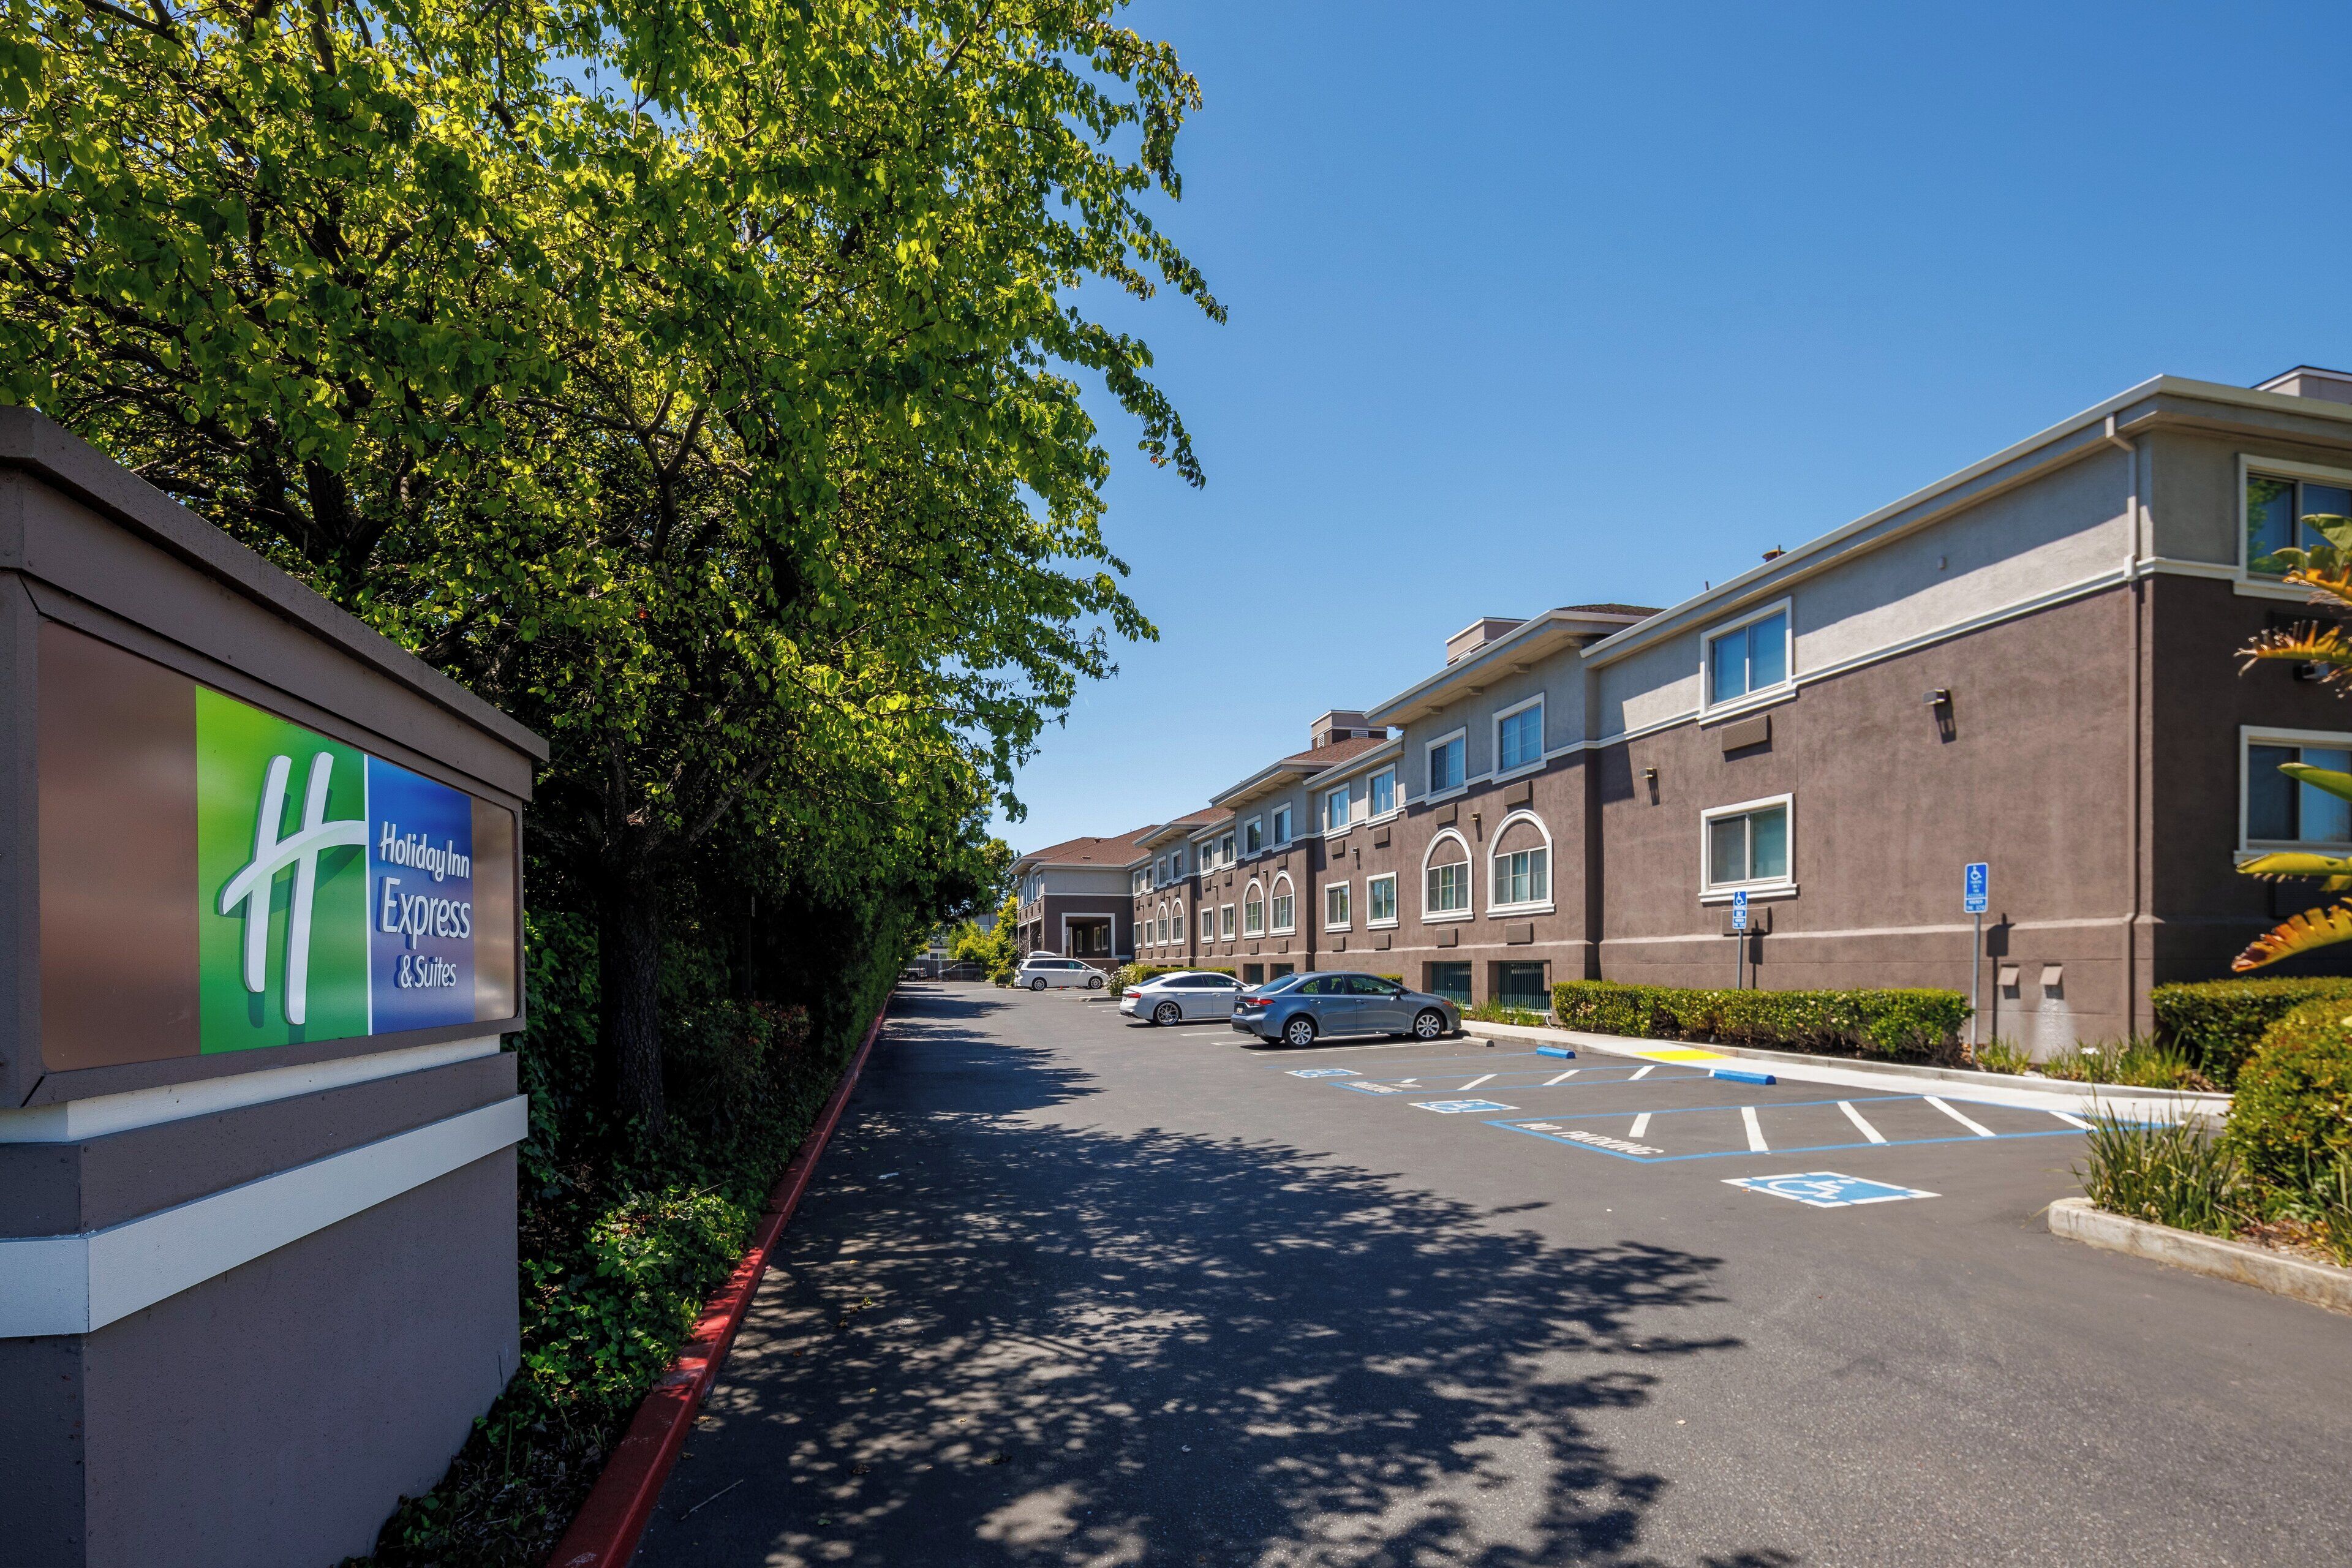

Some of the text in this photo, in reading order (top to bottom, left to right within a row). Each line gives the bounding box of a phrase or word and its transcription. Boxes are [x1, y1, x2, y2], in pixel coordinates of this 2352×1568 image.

[380, 876, 470, 950] Express
[399, 954, 456, 989] & Suites
[1552, 1131, 1665, 1155] PARKING
